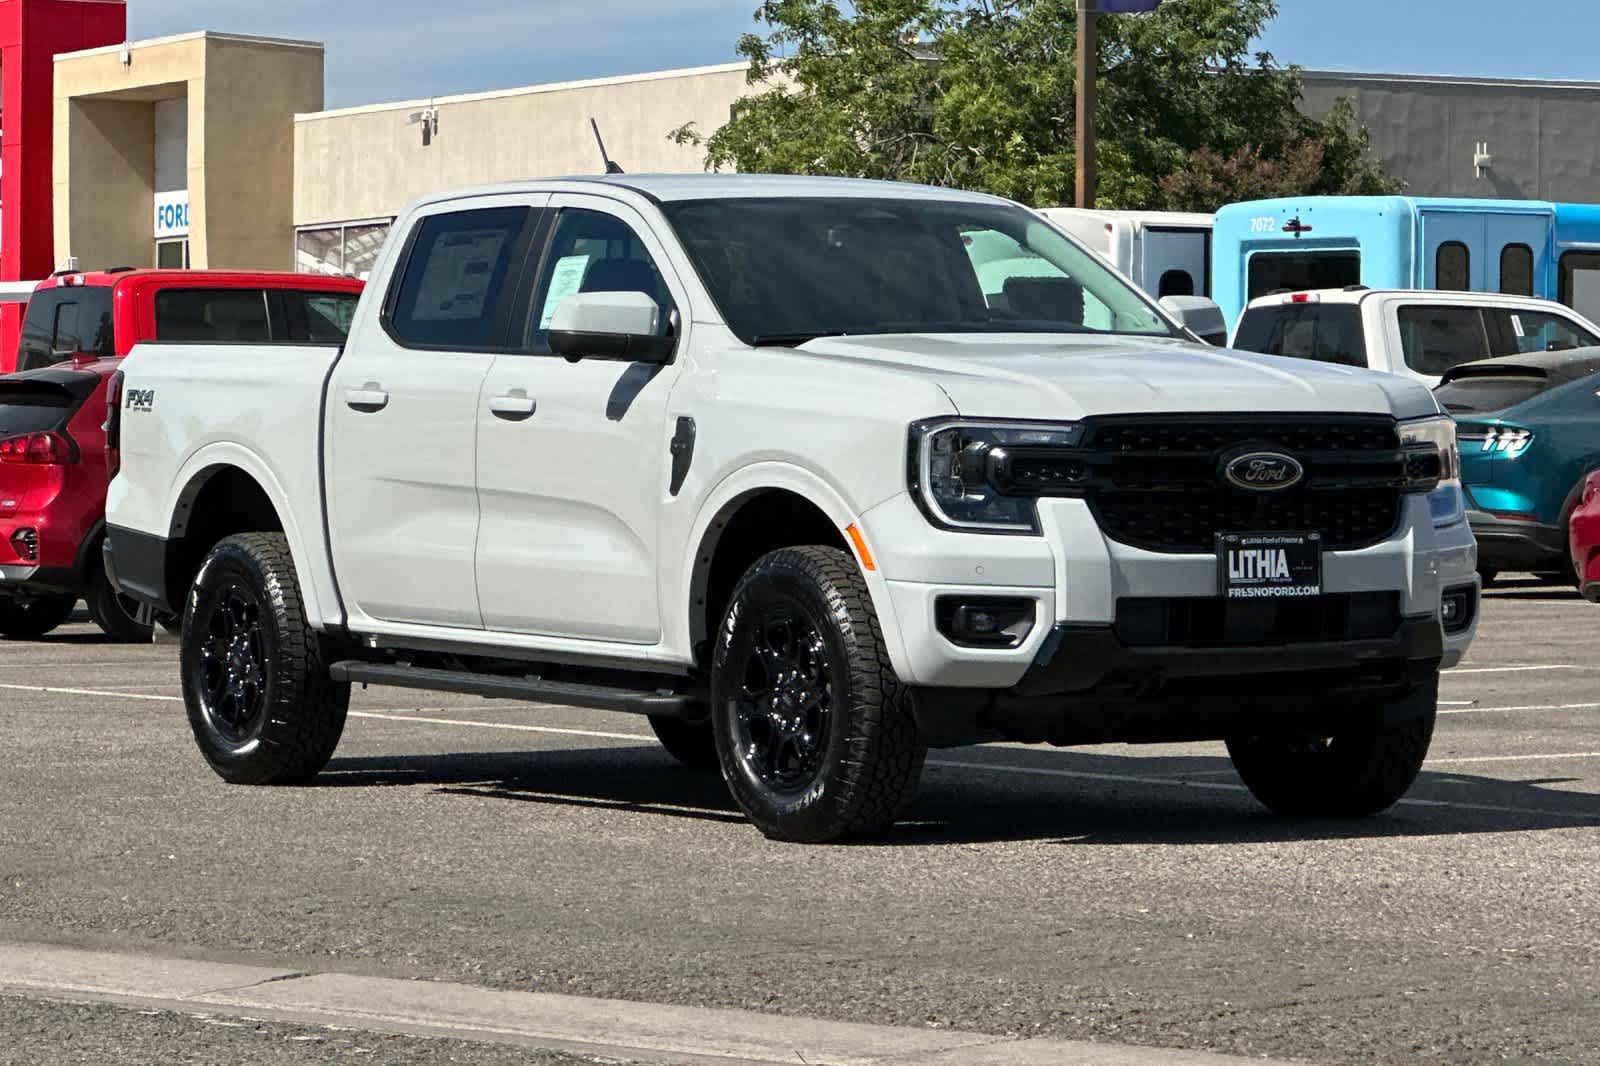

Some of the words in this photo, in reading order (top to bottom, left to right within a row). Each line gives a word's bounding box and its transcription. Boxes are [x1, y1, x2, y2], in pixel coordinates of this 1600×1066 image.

[1251, 216, 1274, 232] 7072
[125, 389, 154, 408] FX4
[1246, 459, 1286, 481] Ford
[1229, 549, 1289, 578] LITHIA
[1228, 584, 1319, 598] FRESNOFORD.COM
